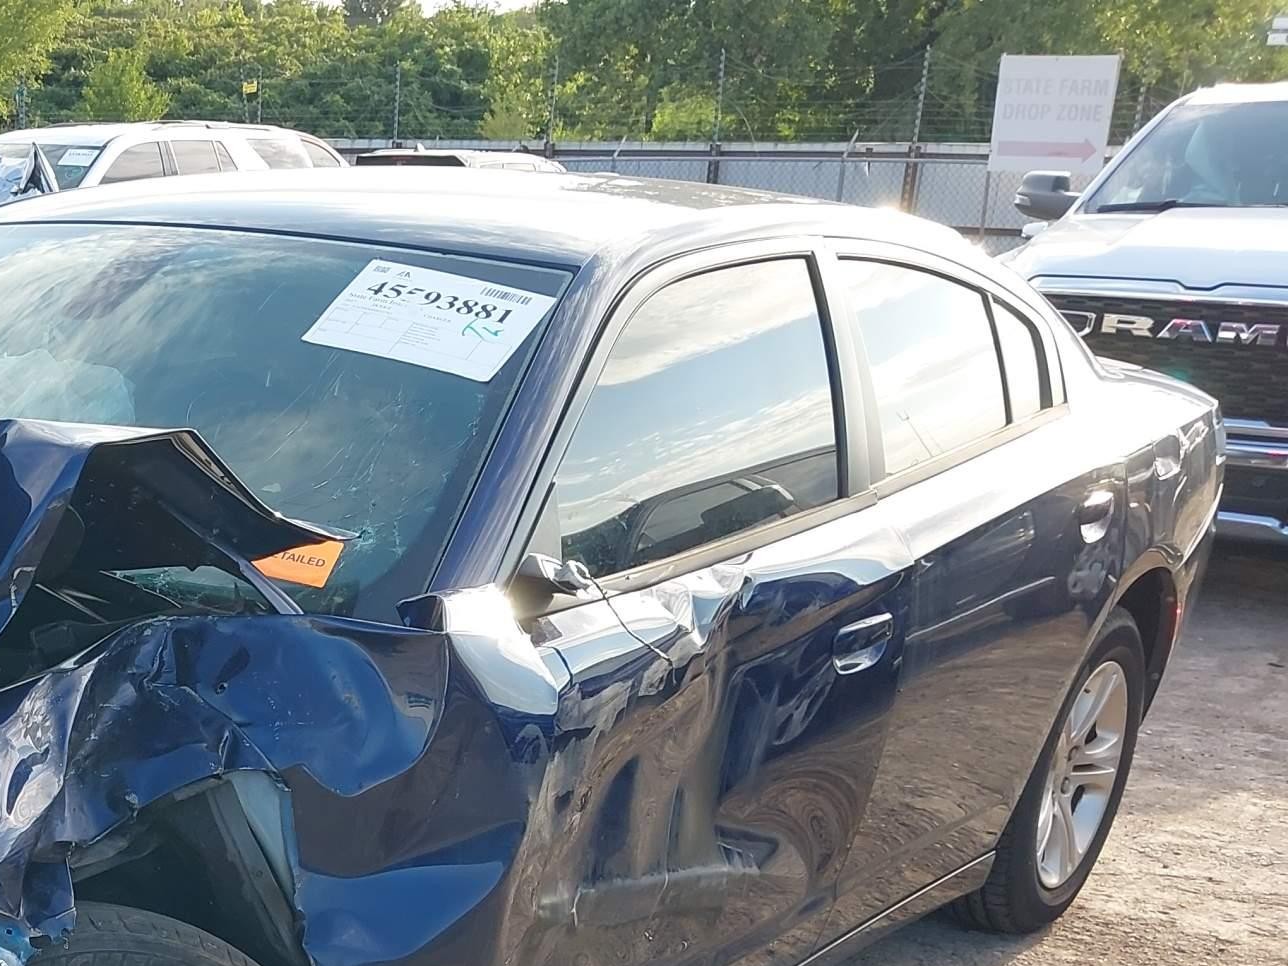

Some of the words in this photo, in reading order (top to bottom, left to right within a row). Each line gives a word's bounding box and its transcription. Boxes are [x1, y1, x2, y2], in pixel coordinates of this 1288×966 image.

[1002, 79, 1054, 96] STATE
[1058, 79, 1110, 96] FARM
[1001, 103, 1051, 121] DROP
[1055, 103, 1105, 121] ZONE
[1101, 313, 1280, 345] RAM
[274, 551, 326, 568] TAILED
